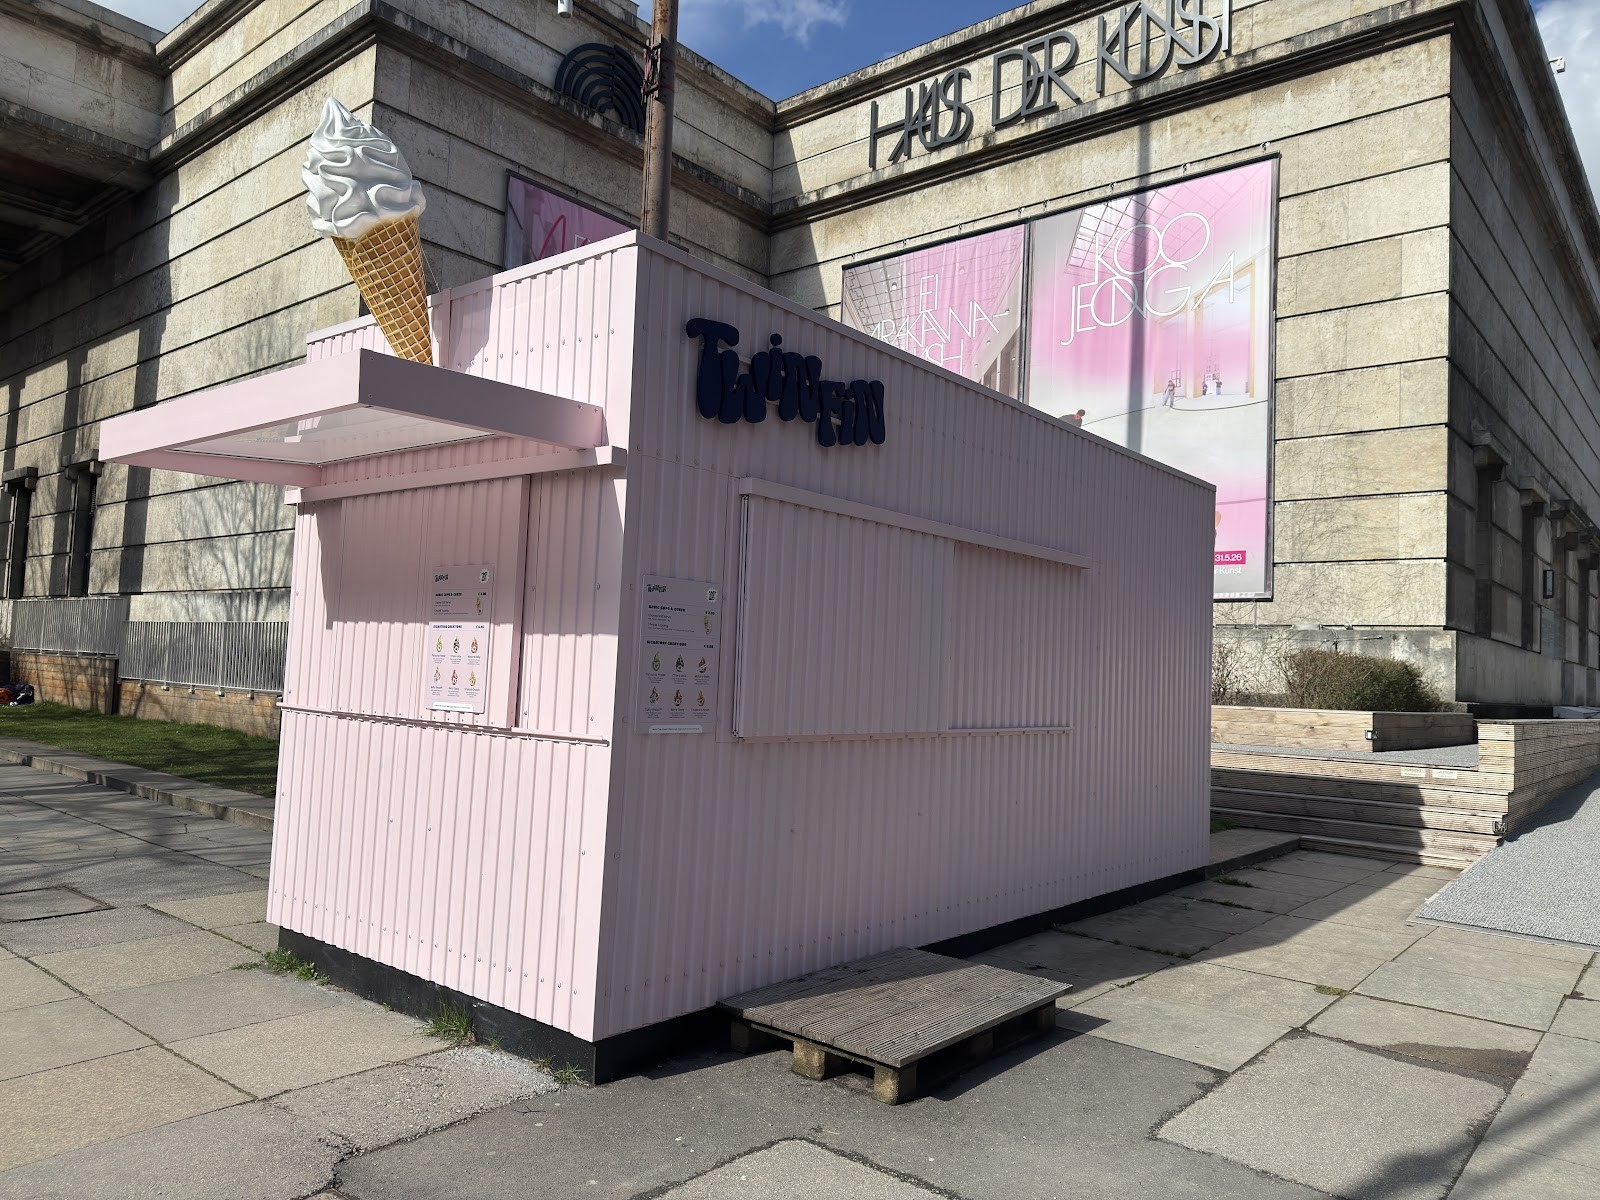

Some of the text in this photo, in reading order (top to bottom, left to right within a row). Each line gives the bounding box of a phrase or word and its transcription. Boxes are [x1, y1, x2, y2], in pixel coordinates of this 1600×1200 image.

[992, 30, 1083, 127] DER
[1094, 212, 1211, 284] KOO
[1219, 566, 1242, 575] Kunst
